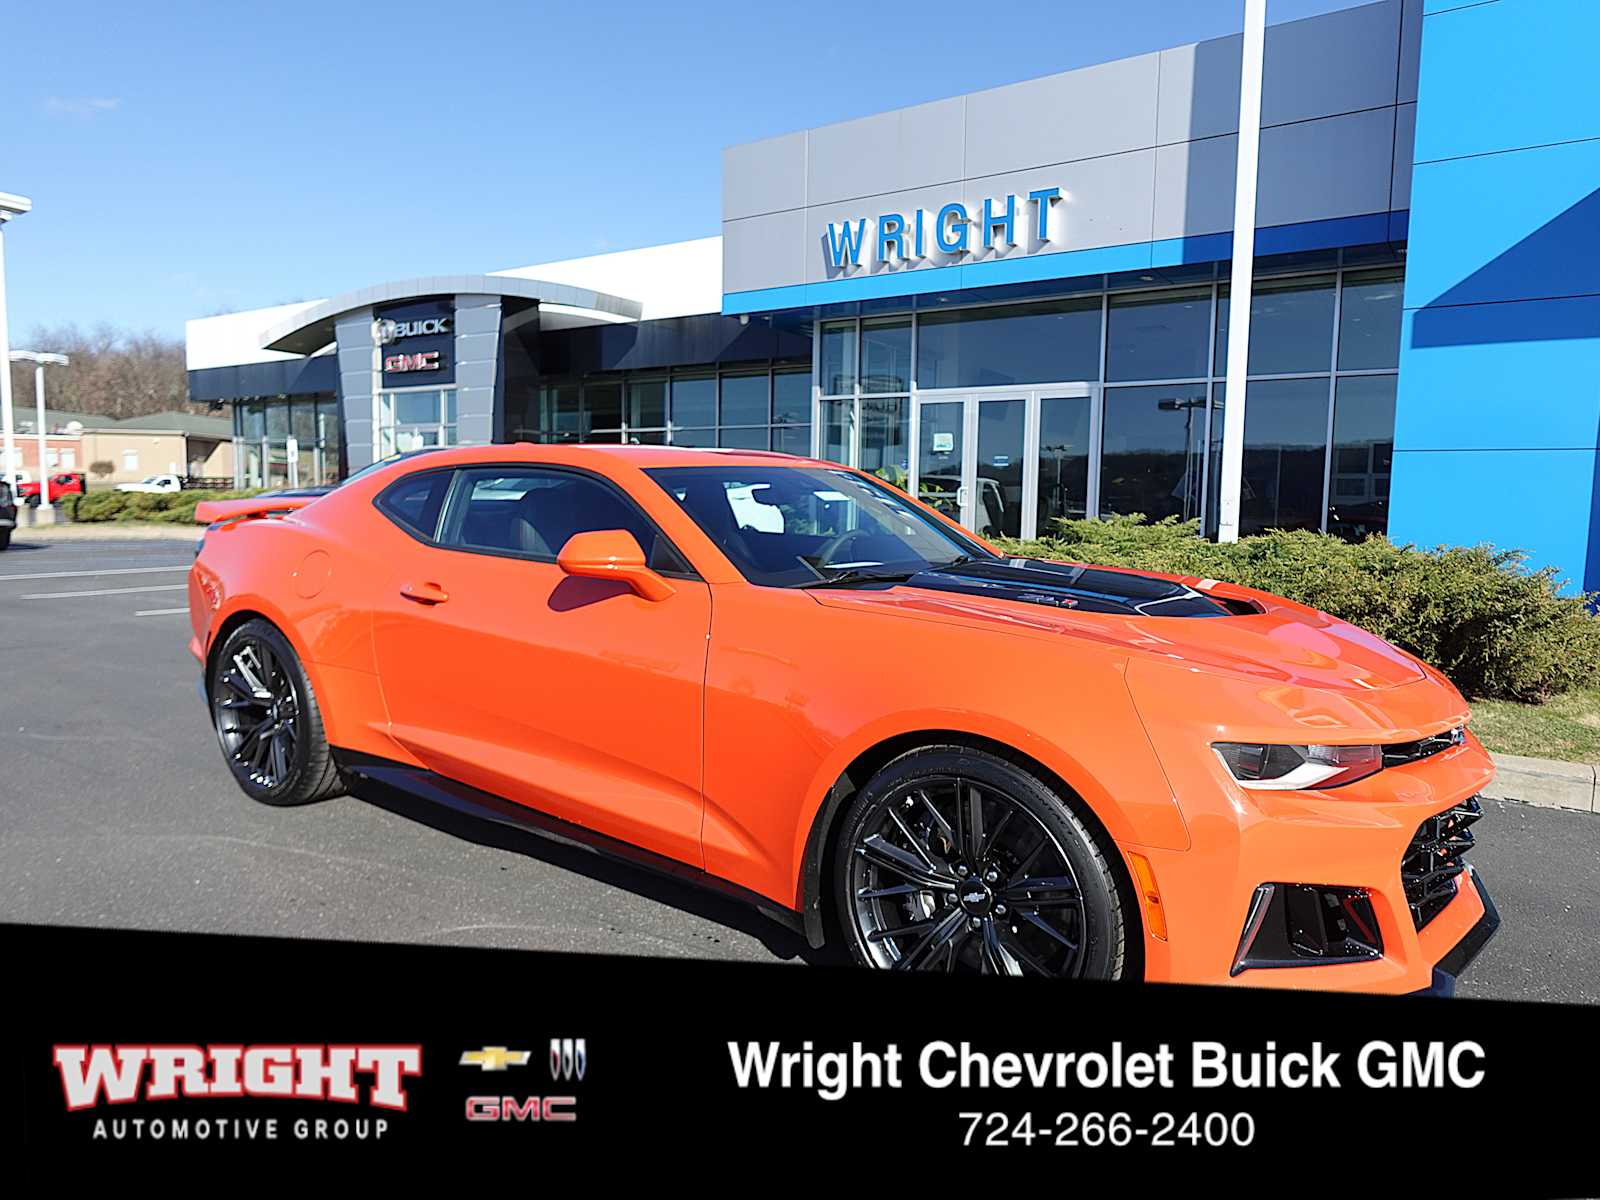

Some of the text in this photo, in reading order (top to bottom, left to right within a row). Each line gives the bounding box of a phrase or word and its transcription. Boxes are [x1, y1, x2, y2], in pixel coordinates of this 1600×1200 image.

[827, 188, 1062, 267] WRIGHT
[394, 318, 448, 337] BUICK
[384, 351, 440, 373] GMC
